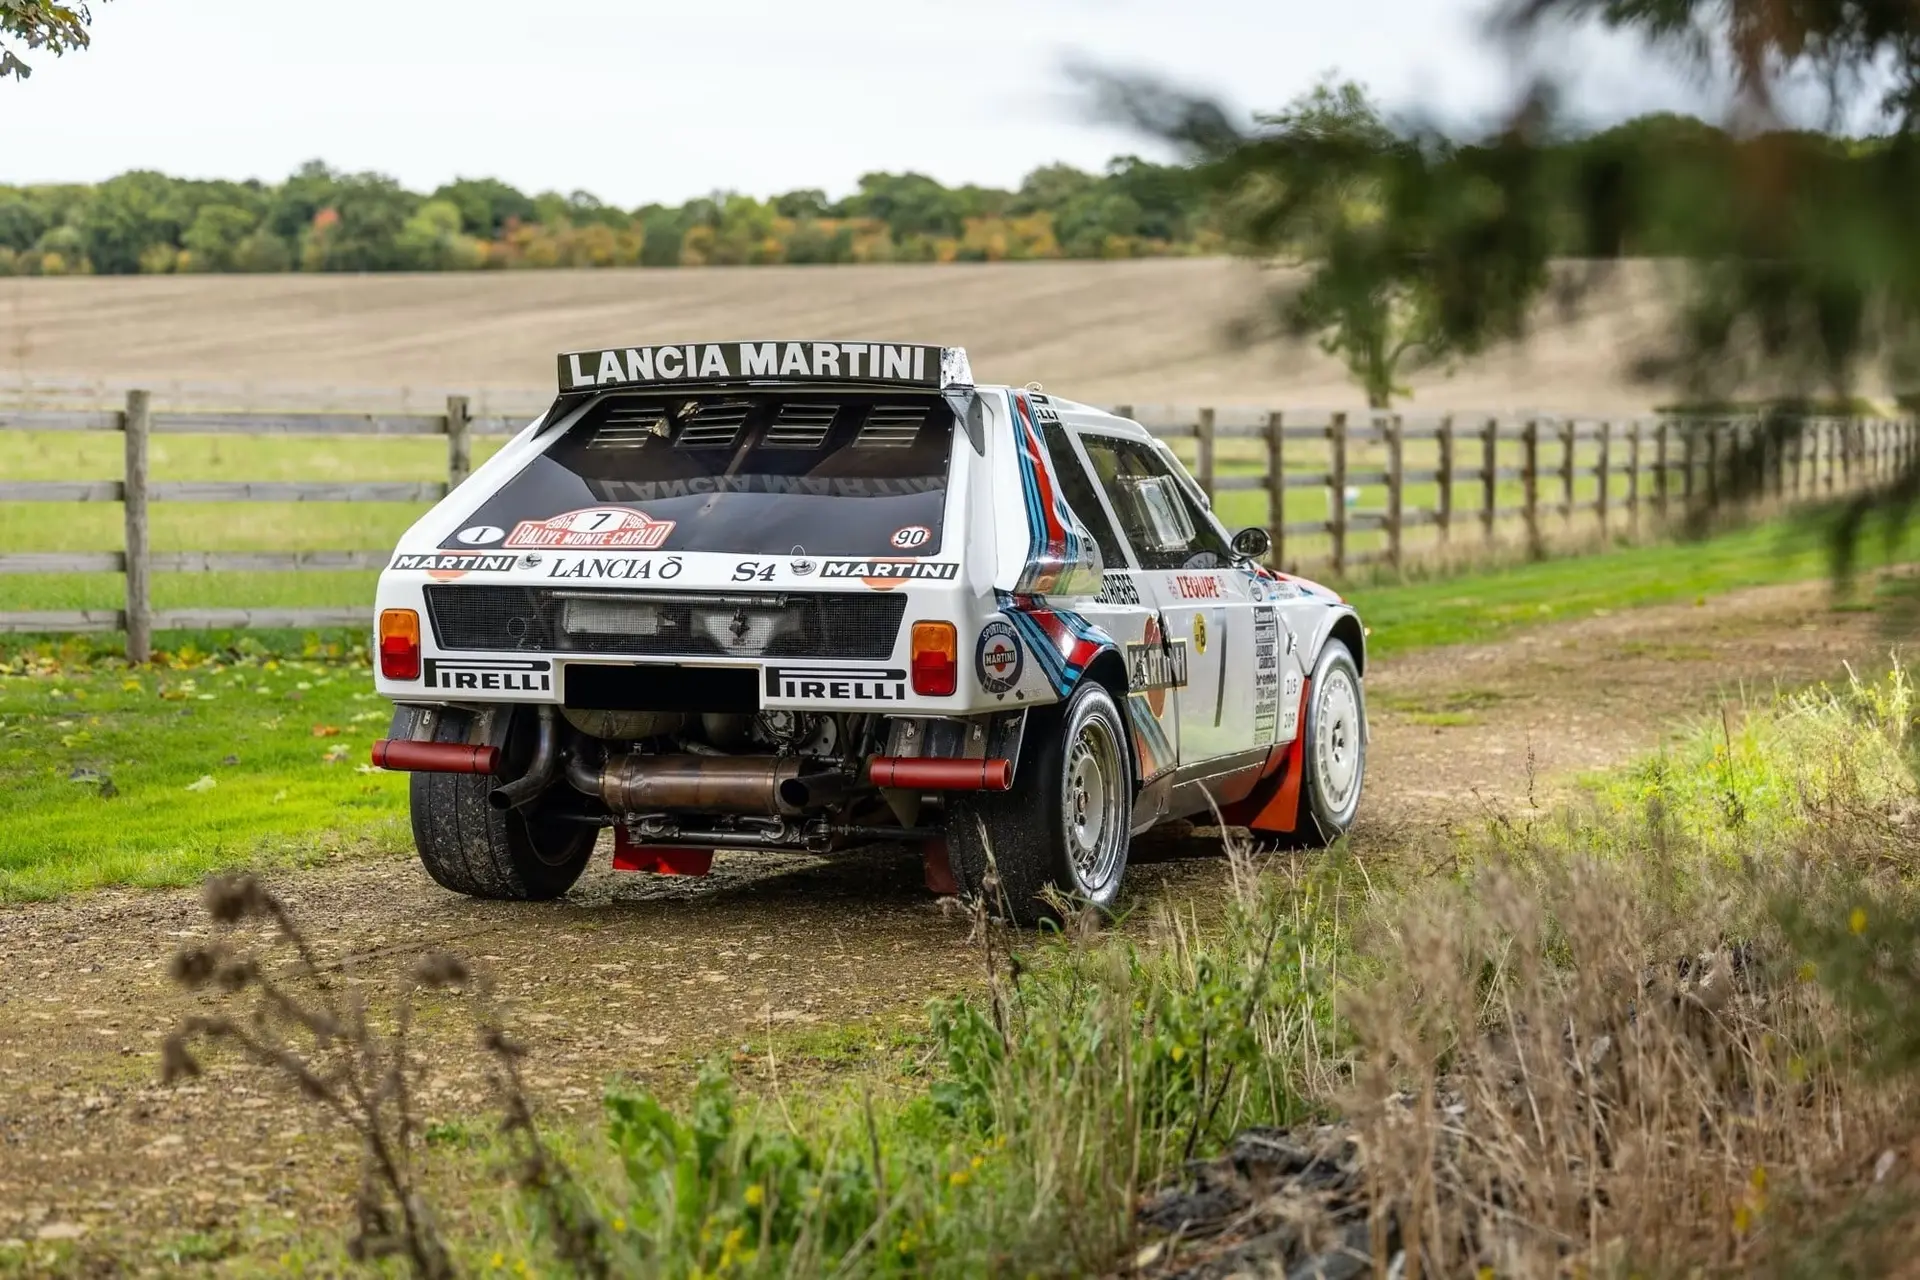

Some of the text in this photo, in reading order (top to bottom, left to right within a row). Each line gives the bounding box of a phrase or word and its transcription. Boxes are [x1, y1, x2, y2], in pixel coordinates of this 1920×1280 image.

[568, 342, 926, 388] LANCIA MARTINI
[589, 513, 613, 531] 7
[512, 523, 666, 546] RALLYE MONTE-CARLO
[894, 529, 926, 546] 90
[395, 555, 515, 571] MARTINI
[547, 558, 652, 579] LANCIA
[731, 561, 777, 582] S4
[824, 562, 955, 579] MARTINI
[1093, 573, 1140, 605] STRIERES
[985, 651, 1016, 666] MARTINI
[424, 657, 551, 692] PIRELLI
[765, 666, 907, 701] PIRELLI
